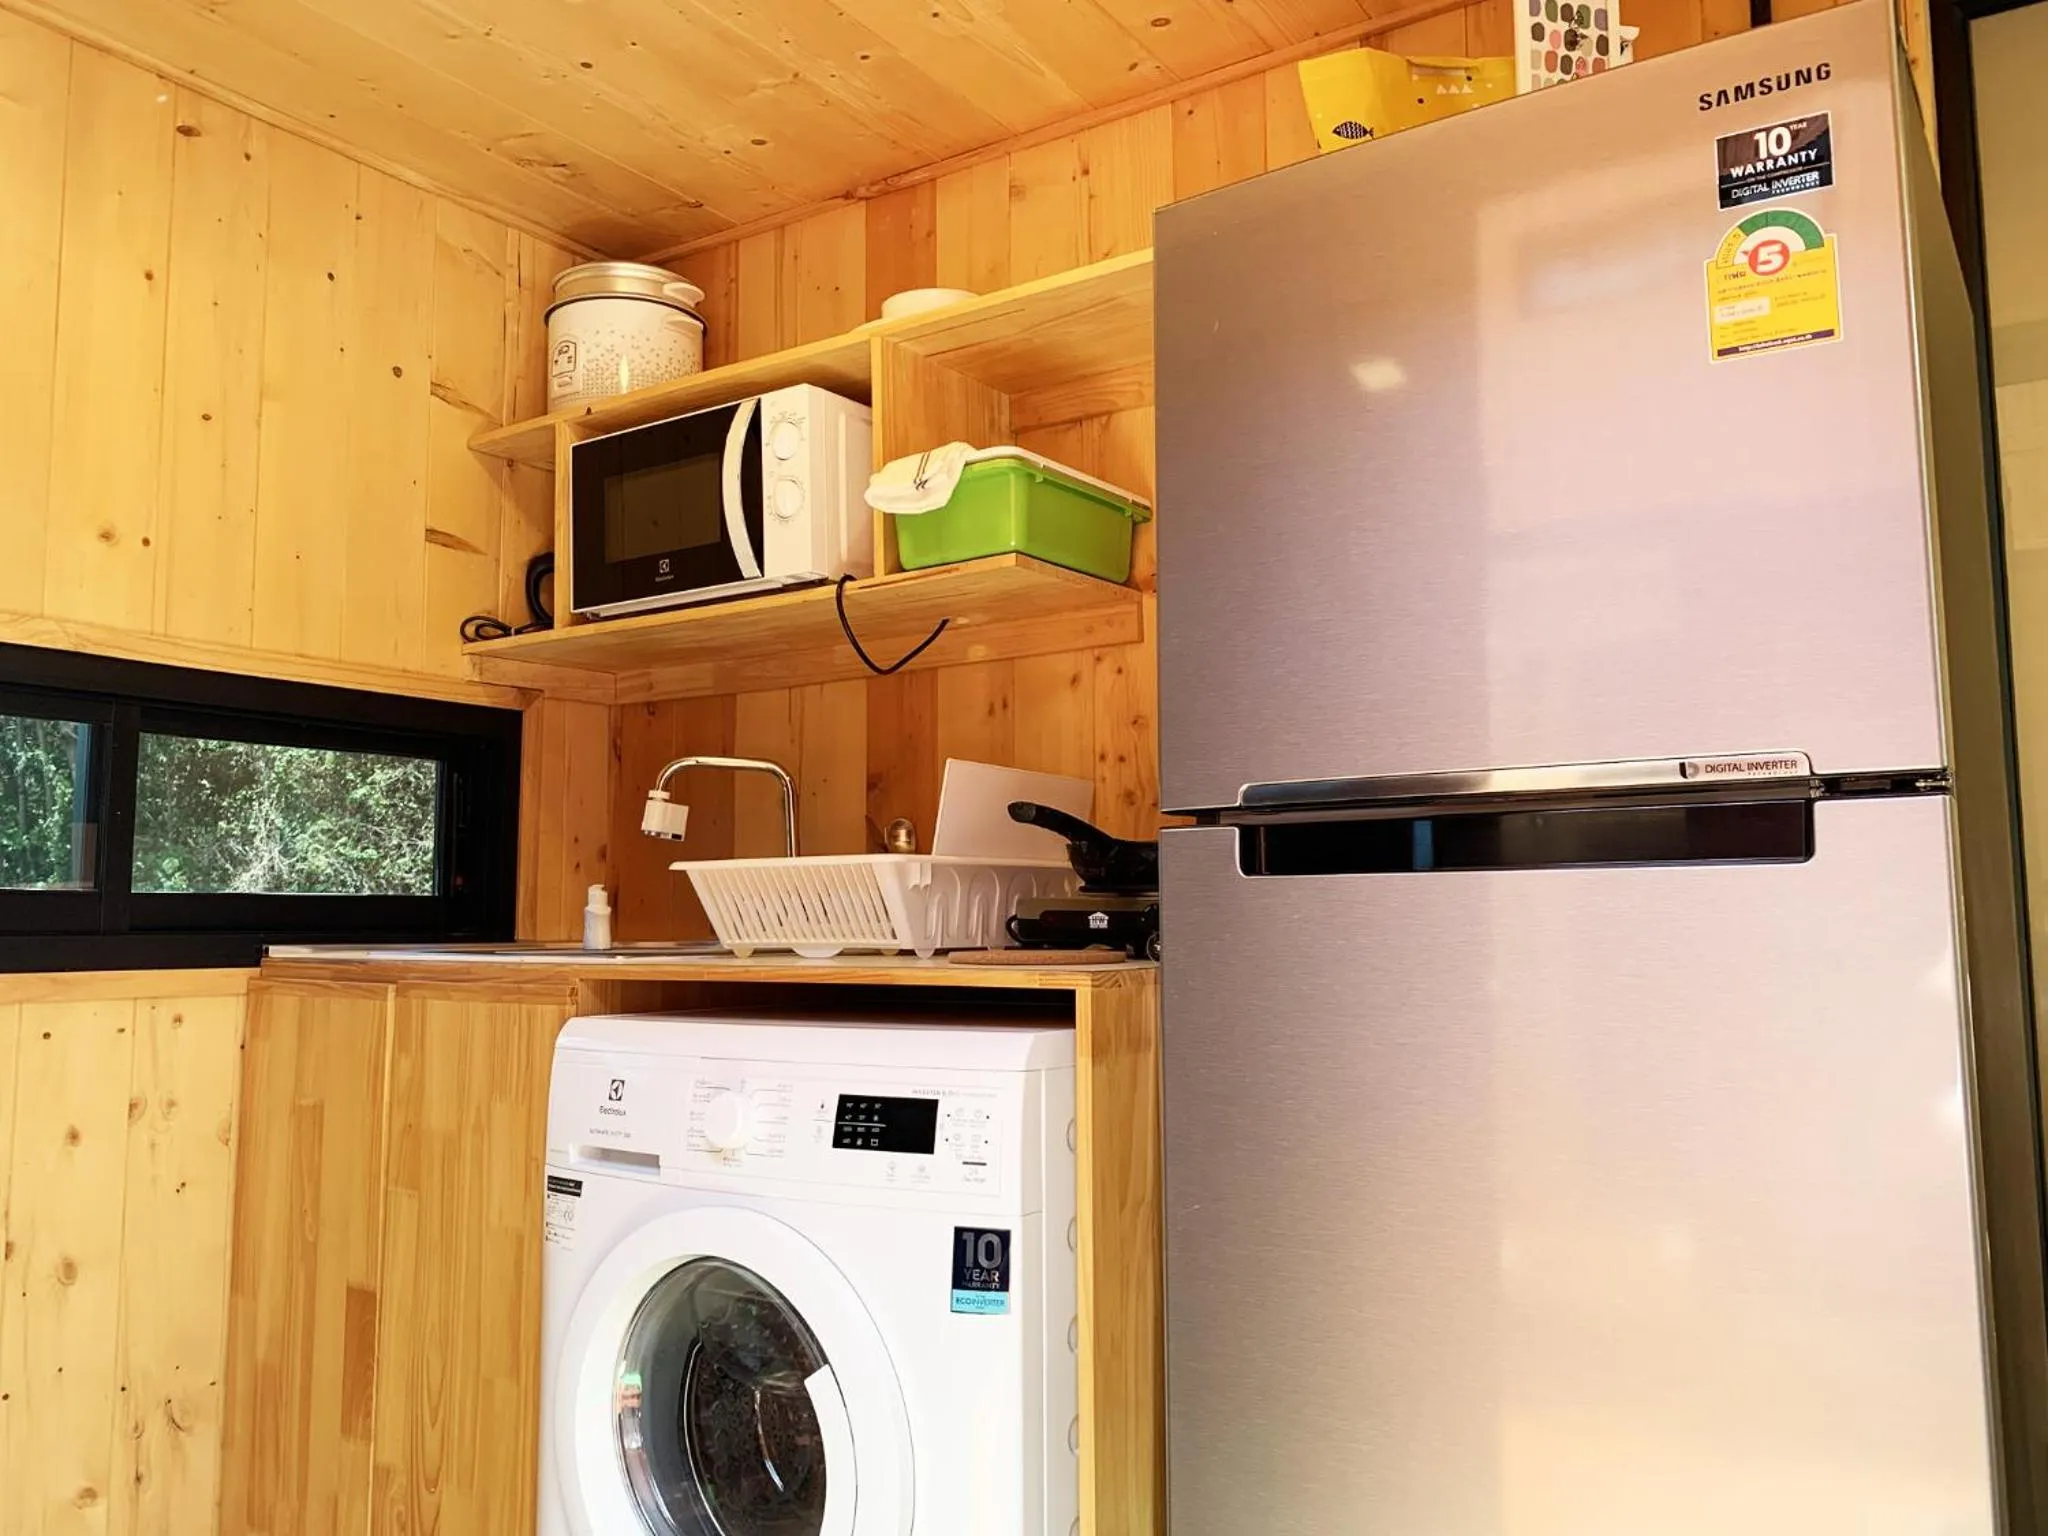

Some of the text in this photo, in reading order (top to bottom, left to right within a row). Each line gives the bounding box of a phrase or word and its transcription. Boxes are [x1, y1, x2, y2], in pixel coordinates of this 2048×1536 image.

[1699, 62, 1831, 111] SAMSUNG
[1753, 126, 1792, 159] 10
[1730, 148, 1818, 178] WARRANTY
[1731, 182, 1770, 199] DIGITAL
[1771, 171, 1820, 190] INVERTER
[1755, 243, 1784, 273] 5
[1704, 759, 1798, 774] DIGITAL INVERTER
[962, 1231, 1002, 1269] 10
[963, 1268, 1000, 1283] YEAR
